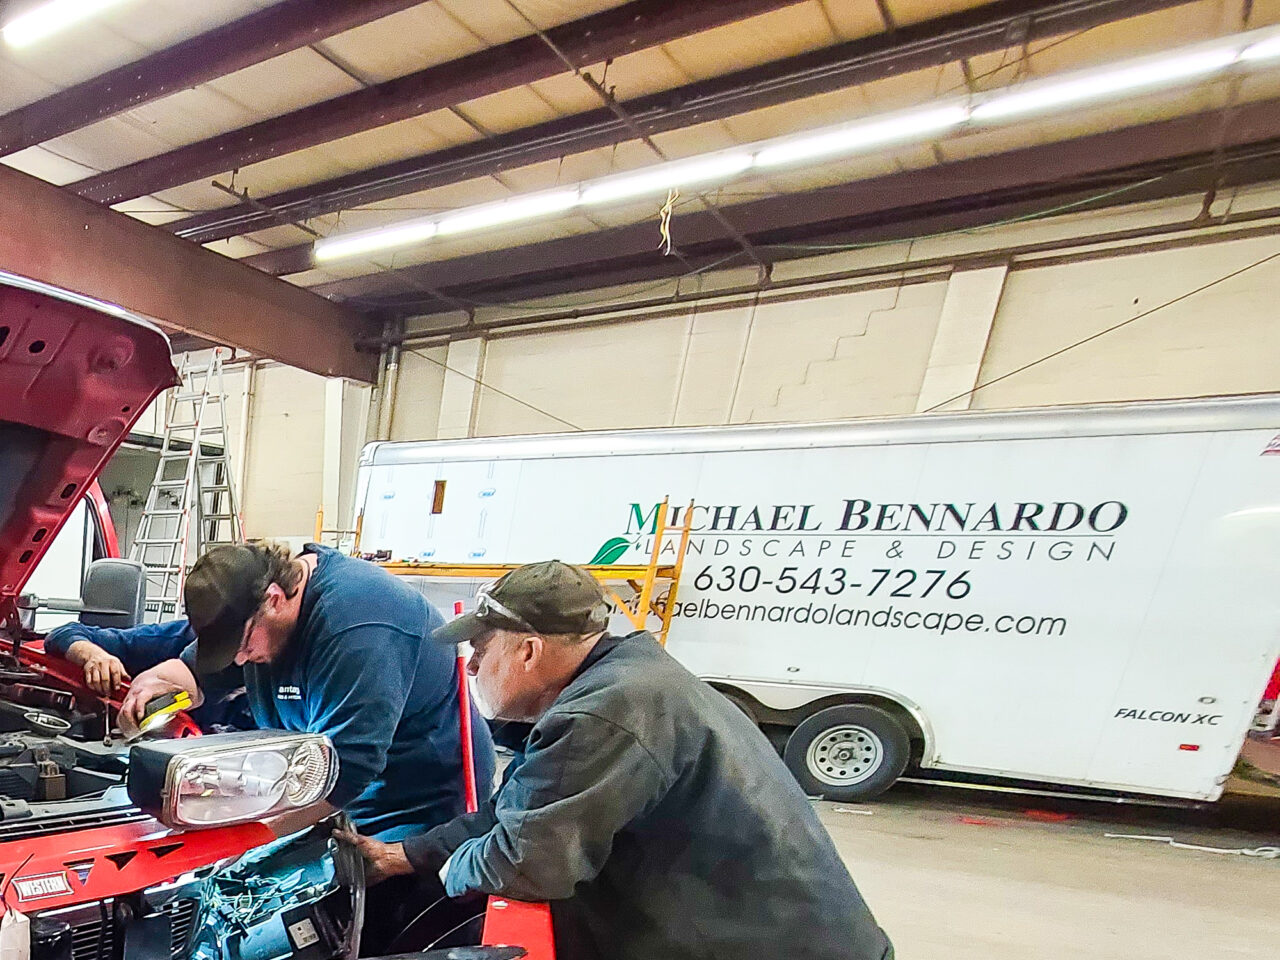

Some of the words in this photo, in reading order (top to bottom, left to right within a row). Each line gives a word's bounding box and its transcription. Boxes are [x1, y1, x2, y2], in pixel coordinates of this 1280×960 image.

[835, 498, 1129, 533] BENNARDO
[644, 539, 857, 558] LANDSCAPE
[885, 540, 904, 559] &
[936, 540, 1116, 562] DESIGN
[693, 564, 972, 600] 630-543-7276
[1114, 708, 1191, 724] FALCON
[1190, 713, 1224, 726] XC
[16, 875, 67, 897] WESTERN
